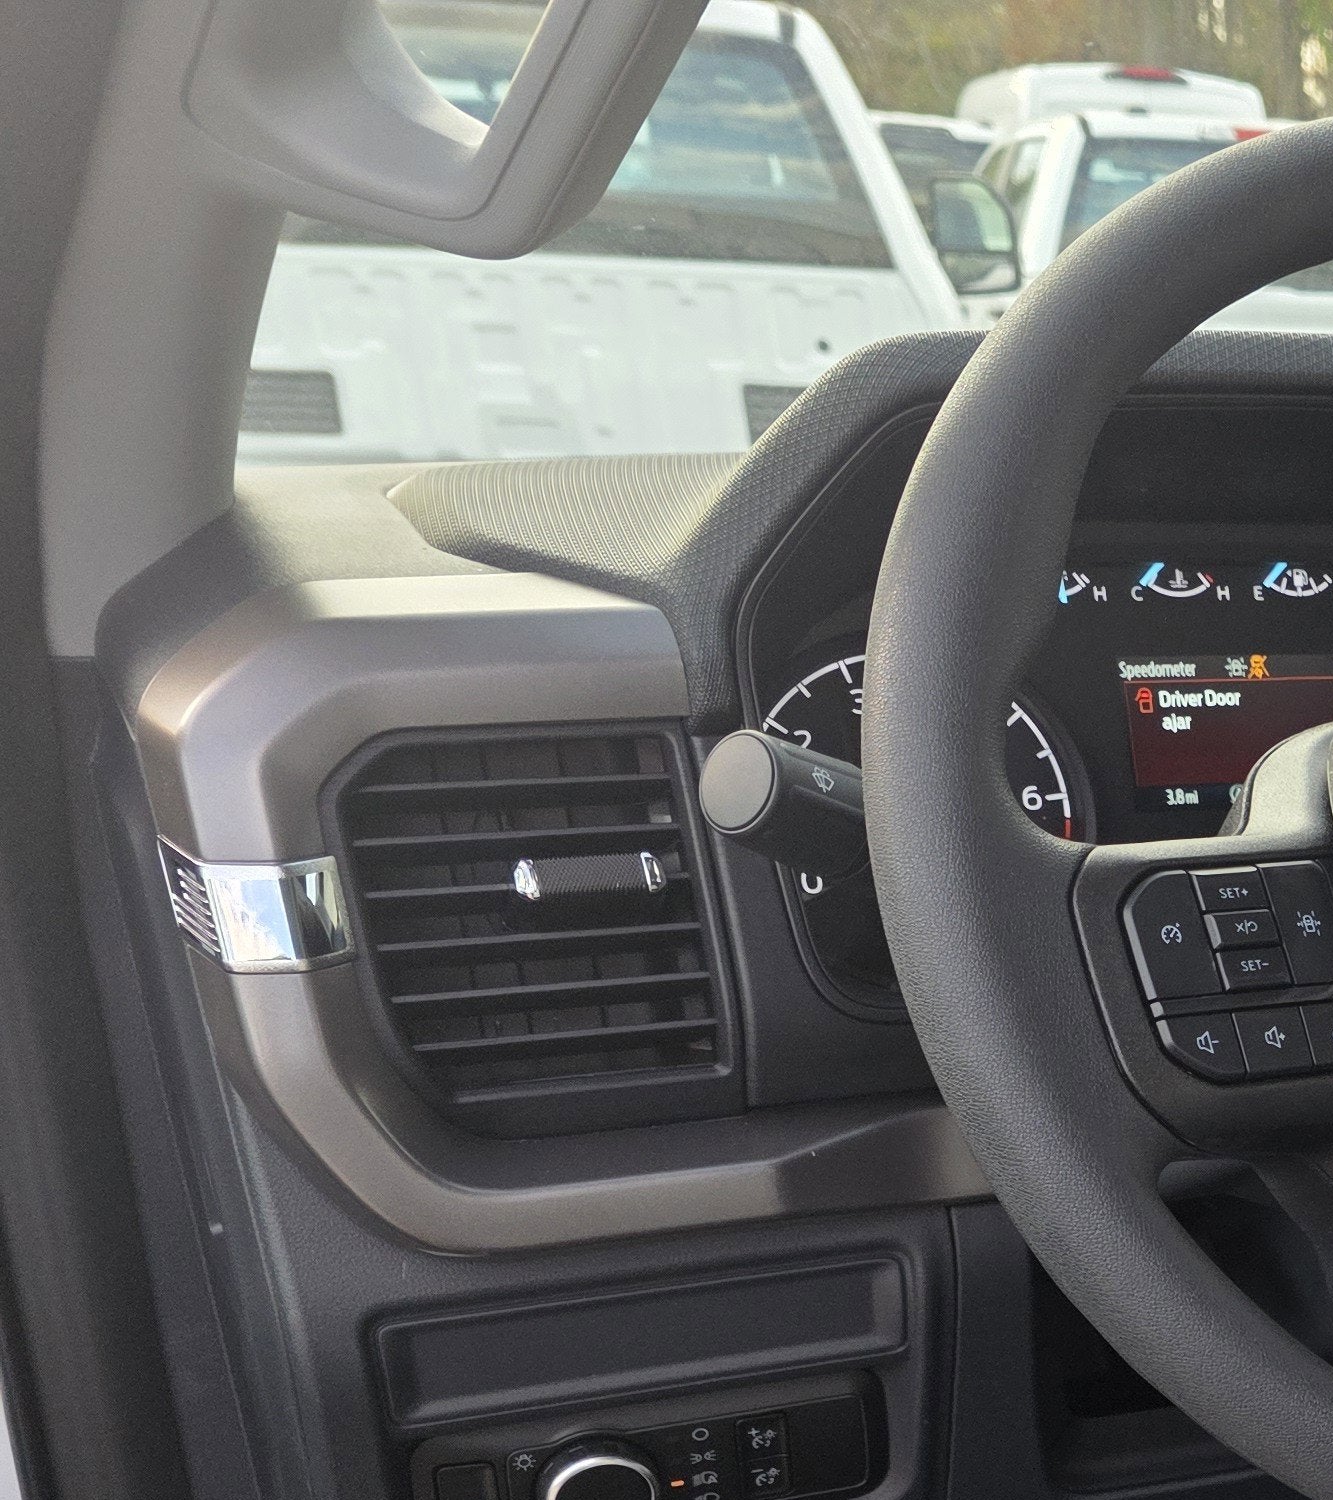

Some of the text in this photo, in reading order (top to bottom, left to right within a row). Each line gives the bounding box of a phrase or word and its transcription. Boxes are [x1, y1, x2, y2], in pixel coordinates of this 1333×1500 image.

[1092, 585, 1108, 602] H
[1130, 585, 1144, 602] C
[1216, 585, 1231, 601] H
[1252, 585, 1265, 601] E
[1118, 660, 1197, 681] Speedometer
[1158, 689, 1242, 708] Driver Door
[1161, 713, 1193, 734] ajar
[1021, 785, 1043, 811] 6
